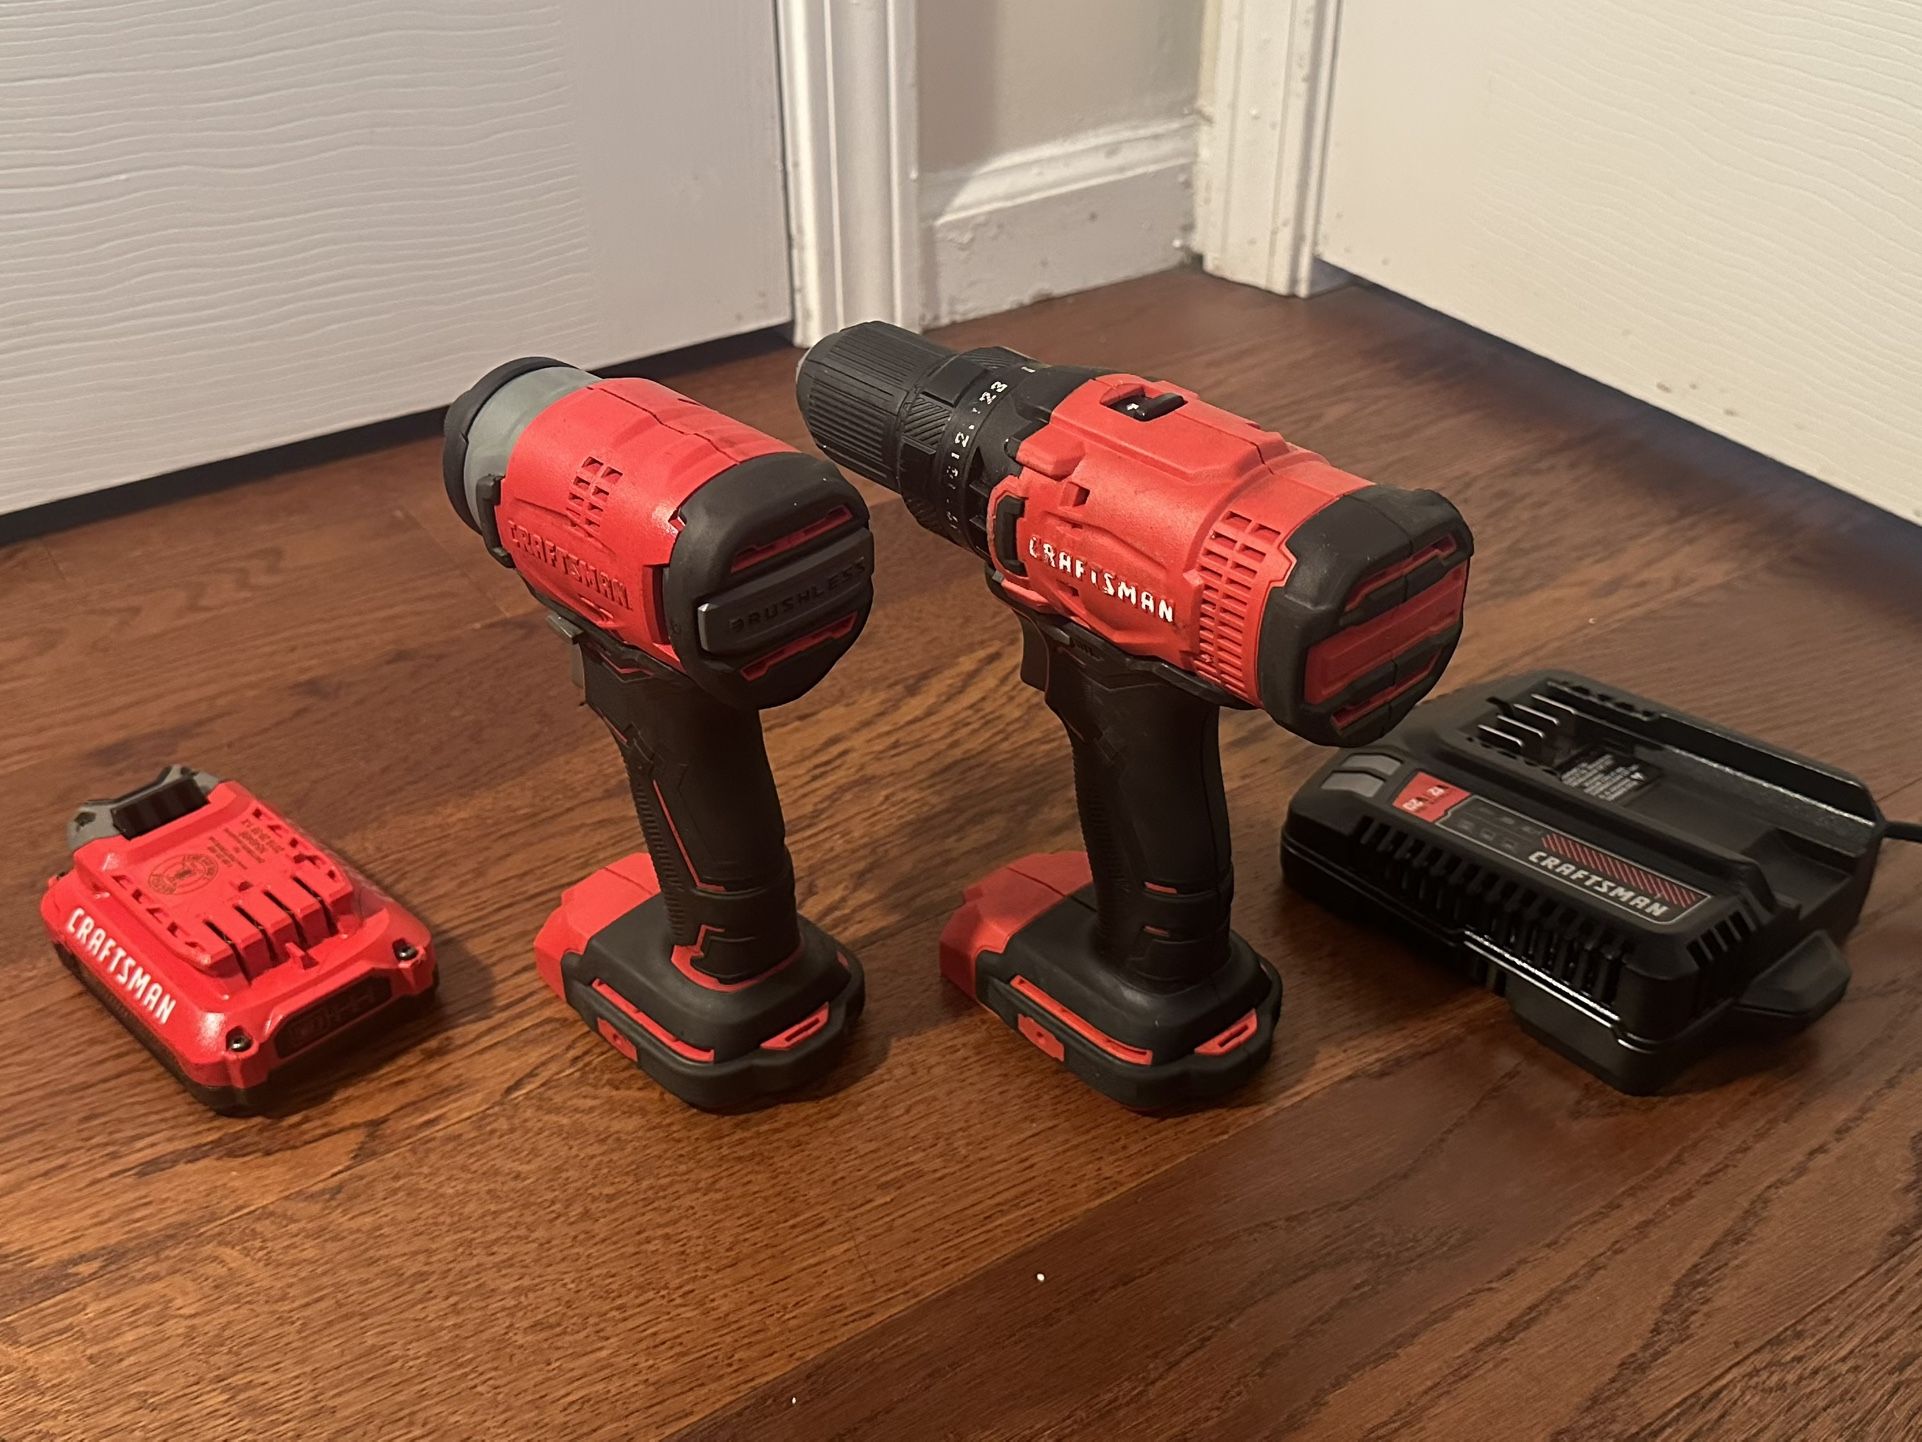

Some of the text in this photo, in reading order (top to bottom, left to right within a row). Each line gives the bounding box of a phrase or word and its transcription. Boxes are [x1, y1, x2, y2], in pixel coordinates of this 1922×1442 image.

[508, 520, 633, 611] CRAFTSMAN
[728, 556, 866, 634] BRUSHLESS
[1029, 535, 1174, 623] CRAFTSMAN
[1528, 850, 1670, 917] CRAFTSMAN
[66, 906, 177, 1025] CRAFTSMAN
